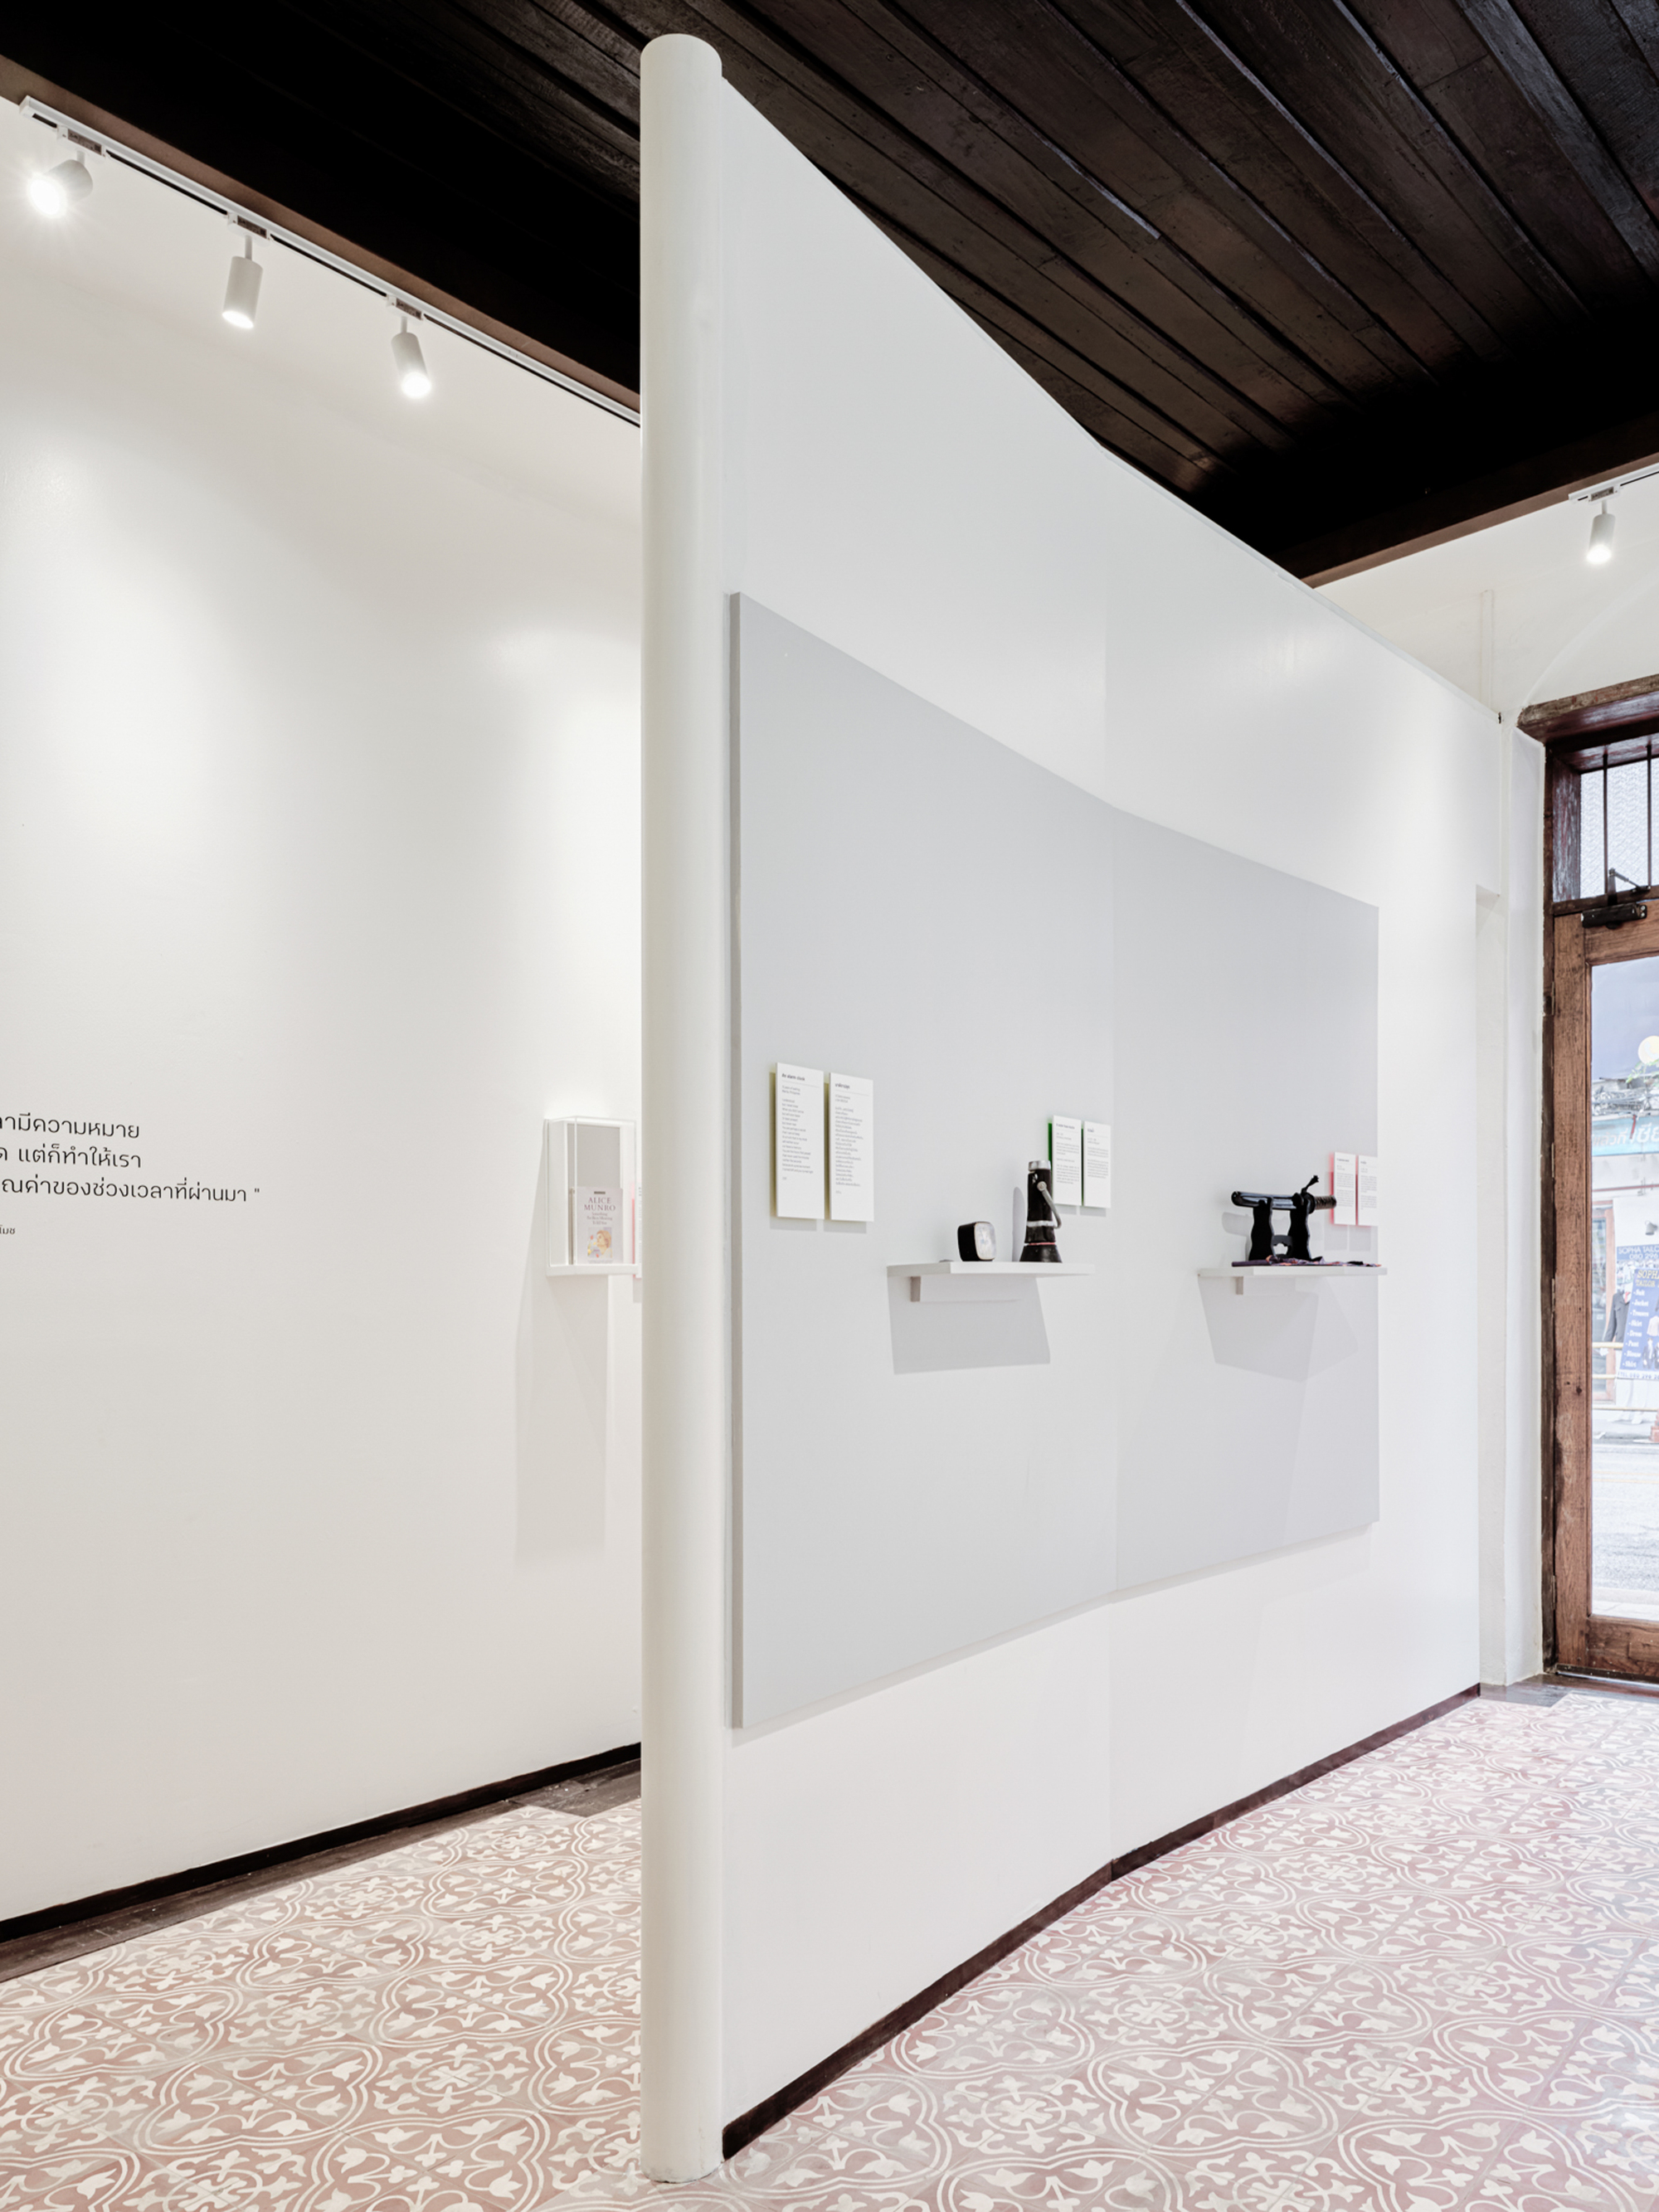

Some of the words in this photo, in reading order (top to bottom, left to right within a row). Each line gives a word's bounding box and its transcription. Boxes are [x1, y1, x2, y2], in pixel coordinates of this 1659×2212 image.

[0, 1111, 140, 1139] ามีความหมาย
[18, 1143, 142, 1168] แต่ก็ทำให้เรา
